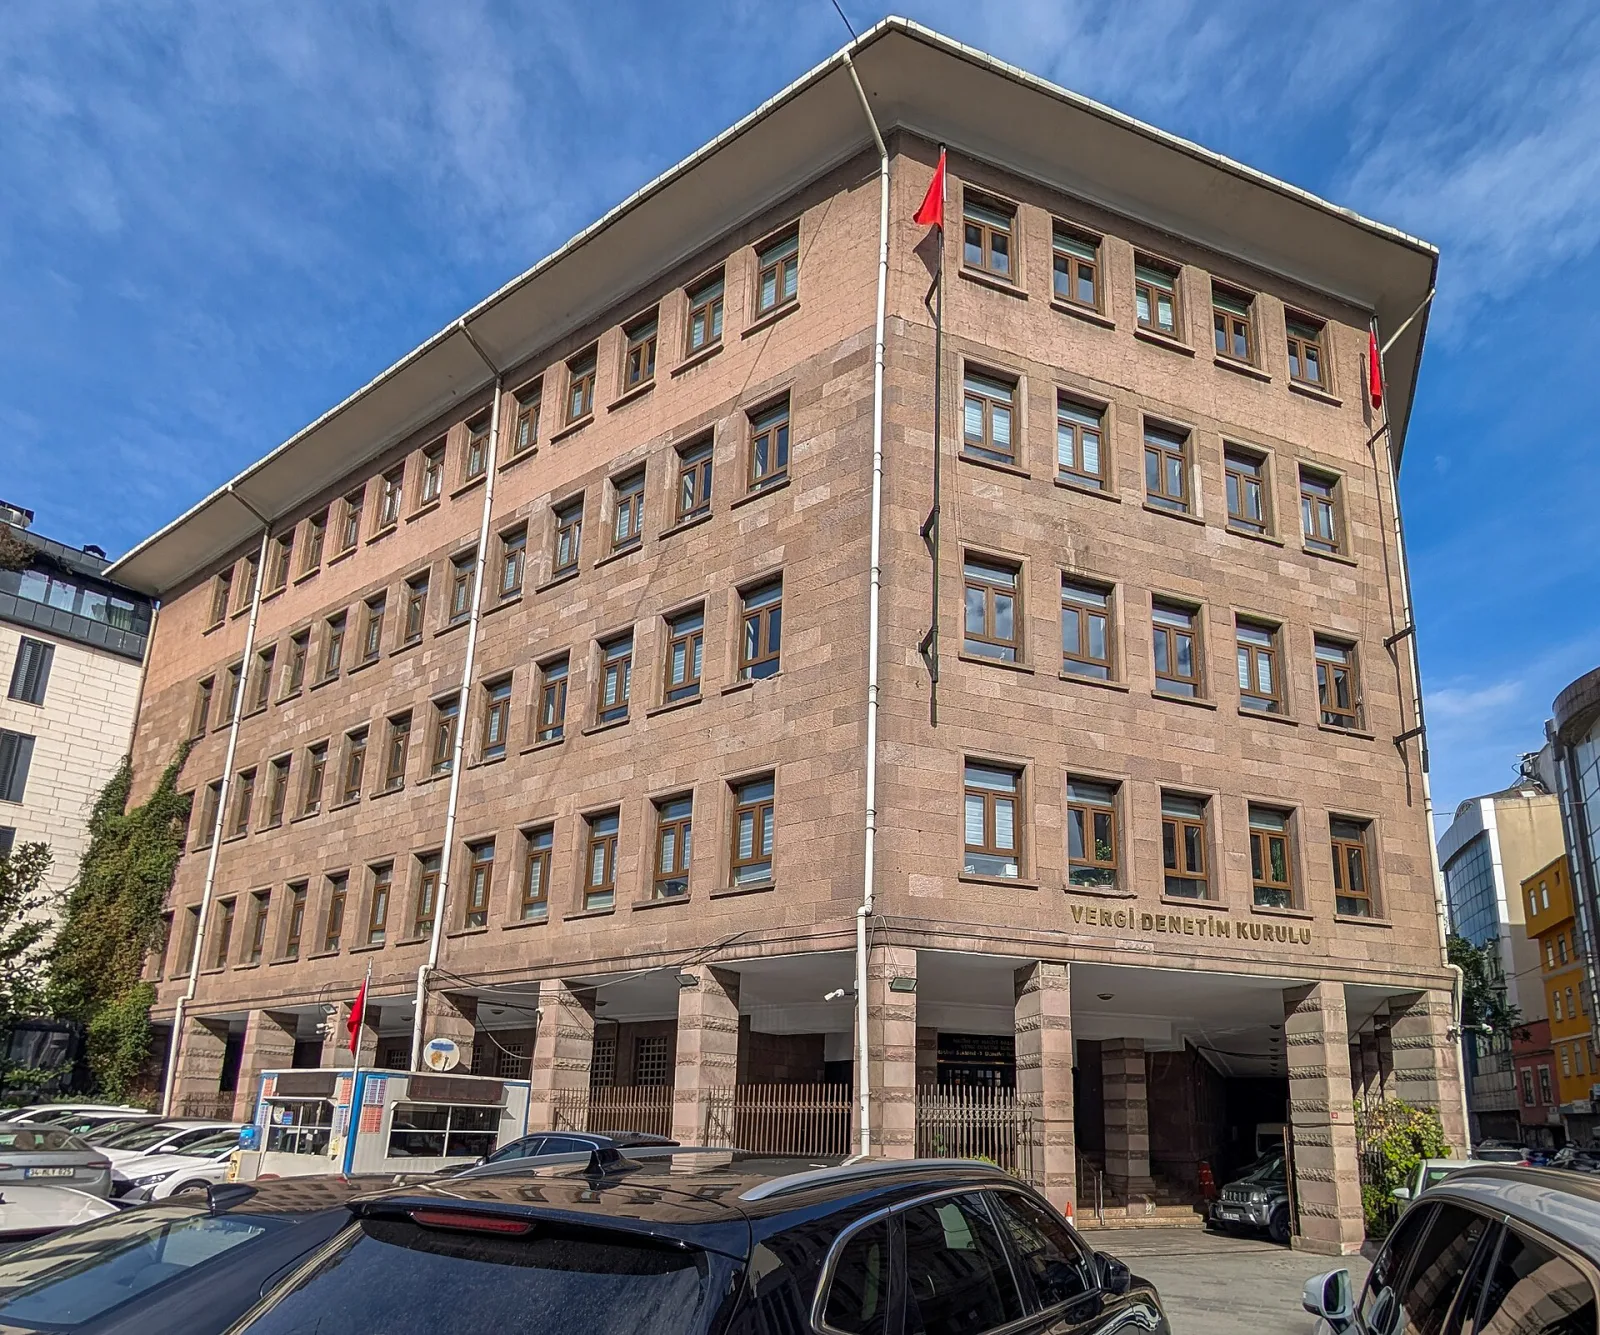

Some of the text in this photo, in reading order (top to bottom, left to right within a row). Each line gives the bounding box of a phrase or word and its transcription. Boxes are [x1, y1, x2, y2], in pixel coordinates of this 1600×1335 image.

[1070, 904, 1311, 945] VERGİ DENETİM KURULU
